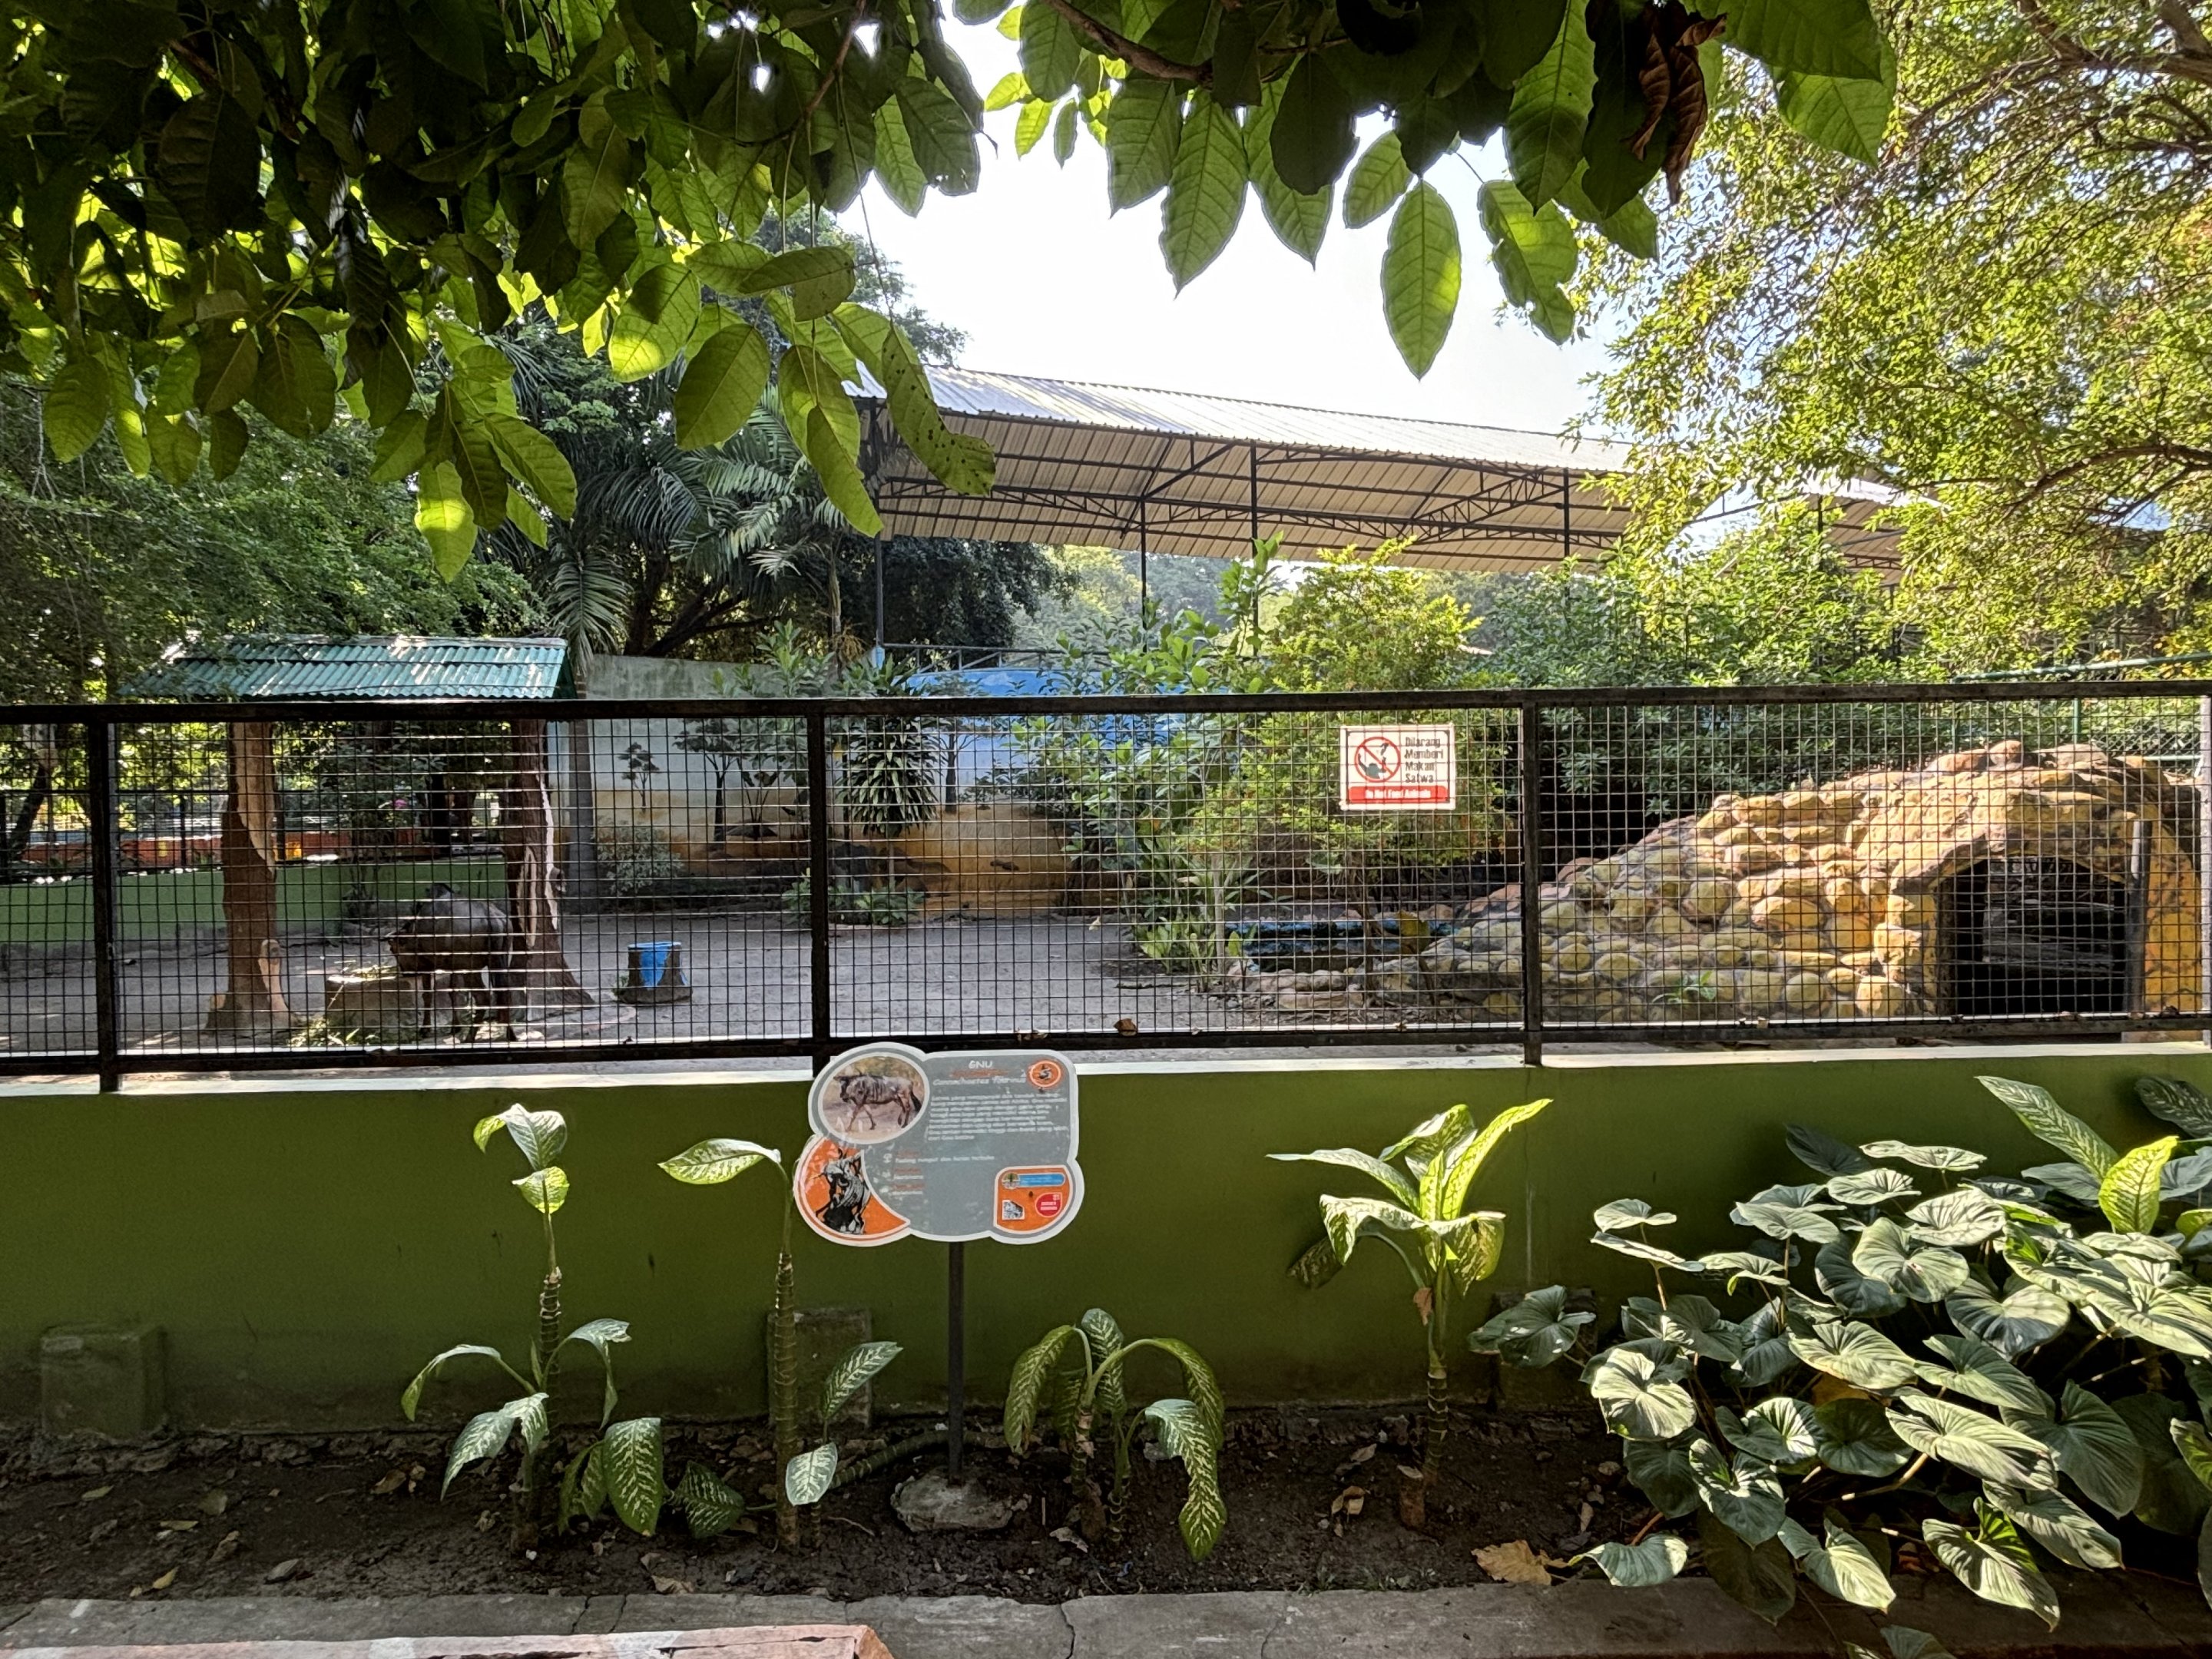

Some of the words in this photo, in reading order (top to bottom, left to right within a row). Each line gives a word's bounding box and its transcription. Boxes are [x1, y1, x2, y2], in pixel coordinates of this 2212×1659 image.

[1406, 737, 1441, 748] Dilarang
[1405, 749, 1444, 759] Memberi
[1406, 761, 1434, 771] Makan
[1406, 773, 1433, 783] Satwa
[969, 1060, 993, 1069] GNU
